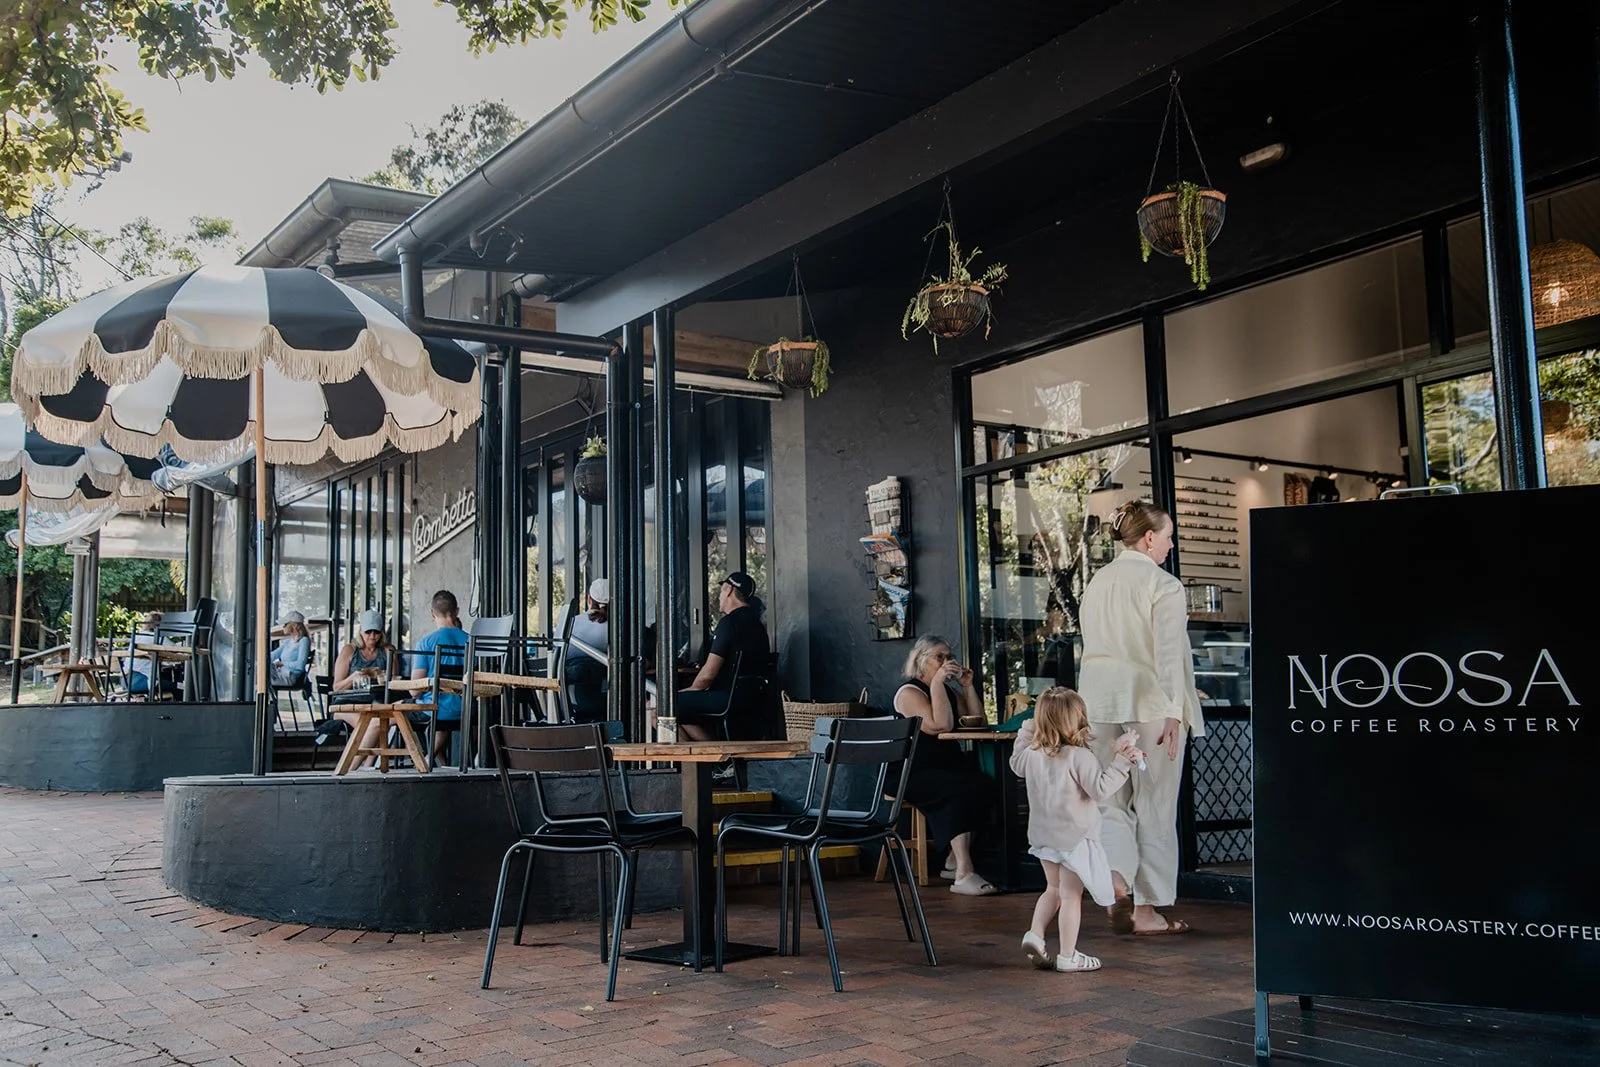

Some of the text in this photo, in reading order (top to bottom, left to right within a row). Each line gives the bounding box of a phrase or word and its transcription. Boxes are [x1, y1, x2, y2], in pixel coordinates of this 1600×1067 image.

[412, 486, 476, 555] Bombetta
[1287, 648, 1581, 709] NOOSA
[1290, 717, 1580, 733] COFFEE ROASTERY
